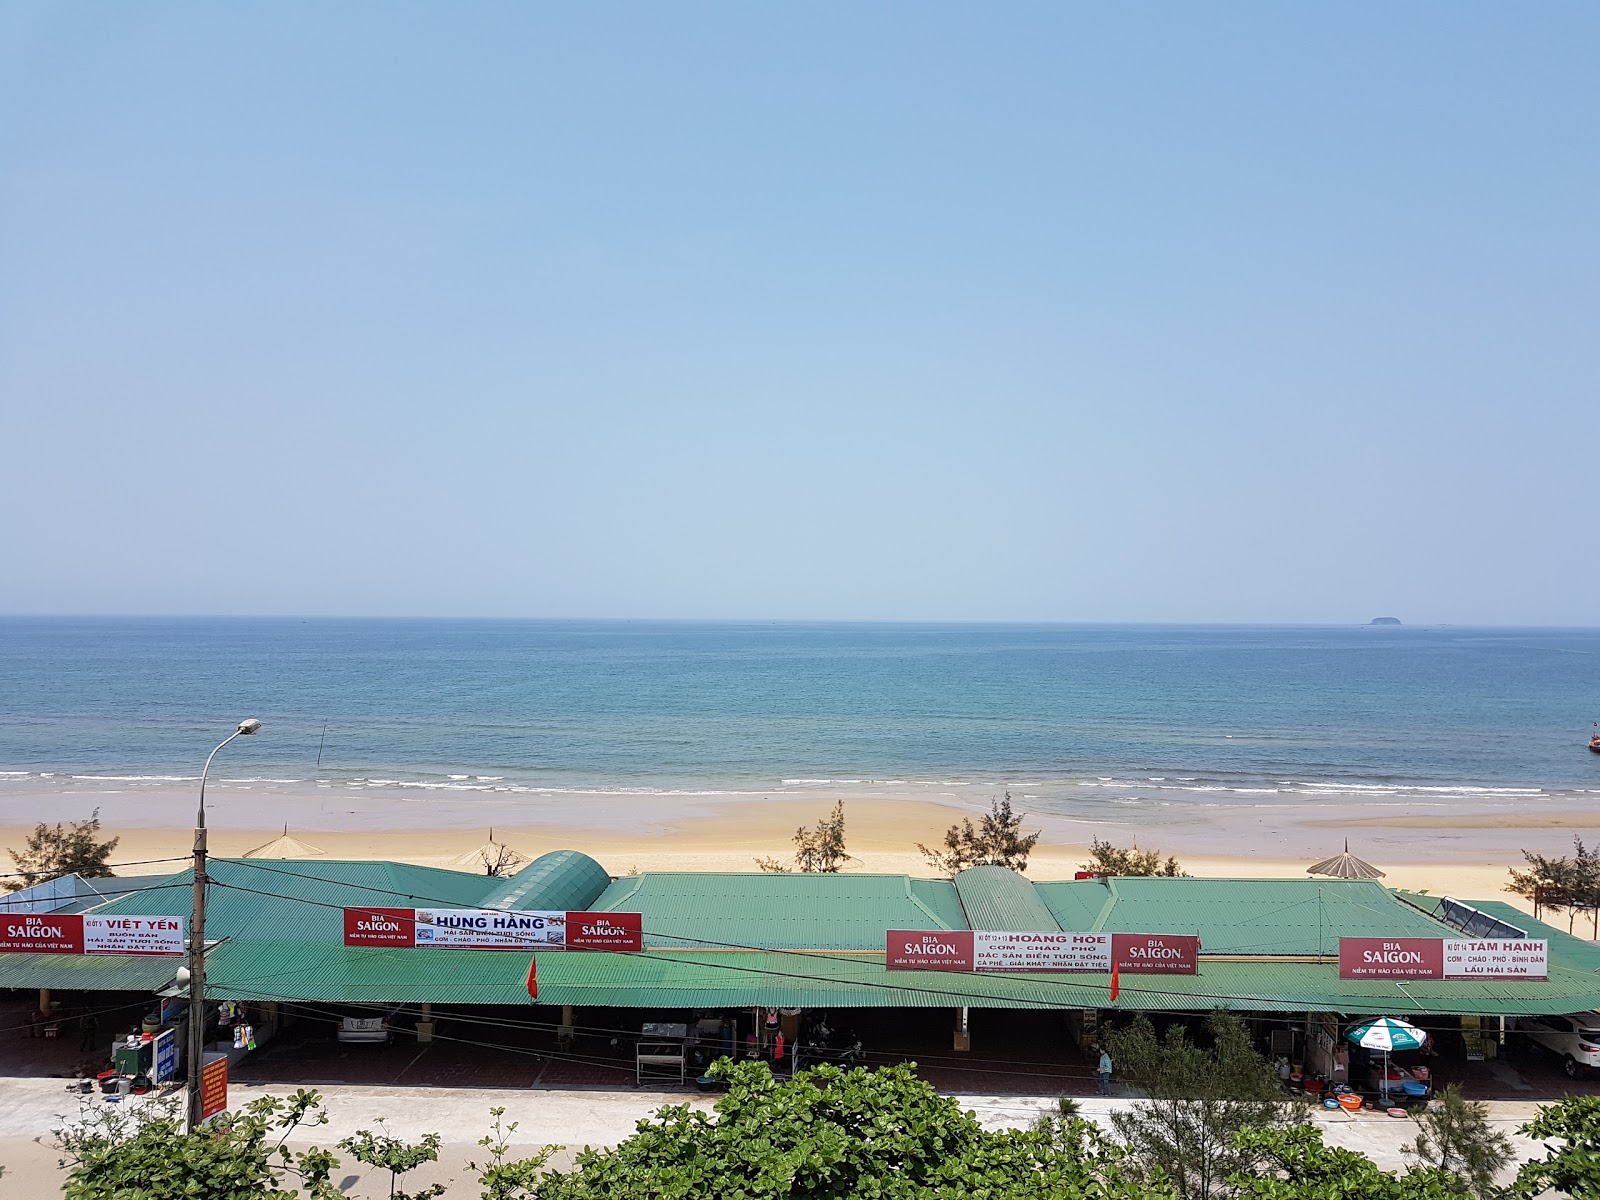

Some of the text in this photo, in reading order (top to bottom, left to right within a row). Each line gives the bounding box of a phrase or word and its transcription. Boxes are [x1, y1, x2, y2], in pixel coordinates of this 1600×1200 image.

[106, 919, 142, 931] VIỆT
[147, 918, 178, 930] YẾN
[437, 915, 487, 928] HÙNG
[1009, 934, 1067, 943] HOÀNG
[1468, 941, 1498, 951] TÁM
[1503, 943, 1543, 953] HẠNH
[1512, 955, 1528, 963] BÌNH
